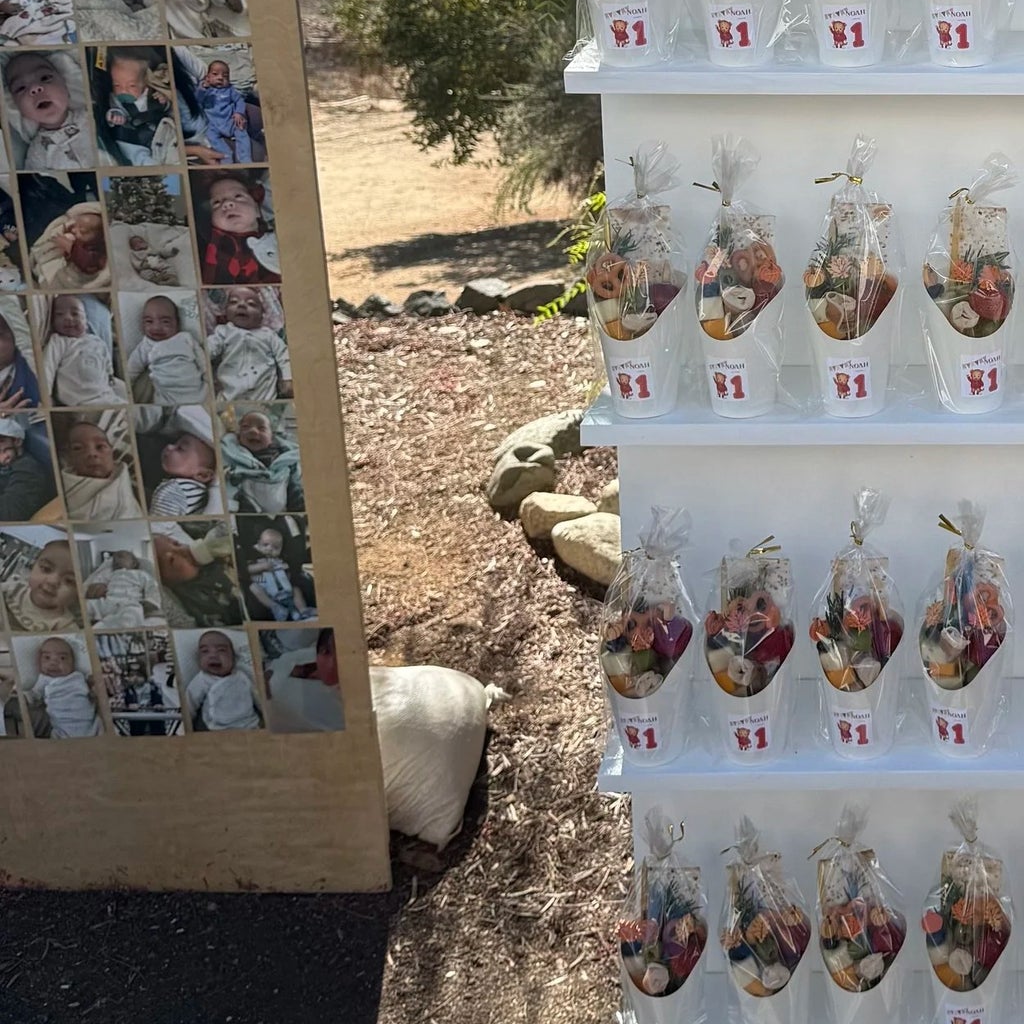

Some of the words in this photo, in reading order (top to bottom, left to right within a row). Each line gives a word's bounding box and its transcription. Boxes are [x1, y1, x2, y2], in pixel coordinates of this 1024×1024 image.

[627, 7, 647, 16] NOAH
[846, 9, 866, 17] NOAH
[951, 10, 971, 18] NOAH
[632, 20, 647, 46] 1
[735, 21, 751, 47] 1
[850, 22, 864, 48] 1
[955, 23, 970, 49] 1
[984, 355, 1001, 364] NOAH
[635, 374, 651, 399] 1
[730, 374, 745, 399] 1
[853, 374, 867, 398] 1
[987, 367, 998, 392] 1
[642, 727, 658, 749] 1
[754, 727, 768, 749] 1
[855, 724, 869, 745] 1
[951, 723, 965, 744] 1
